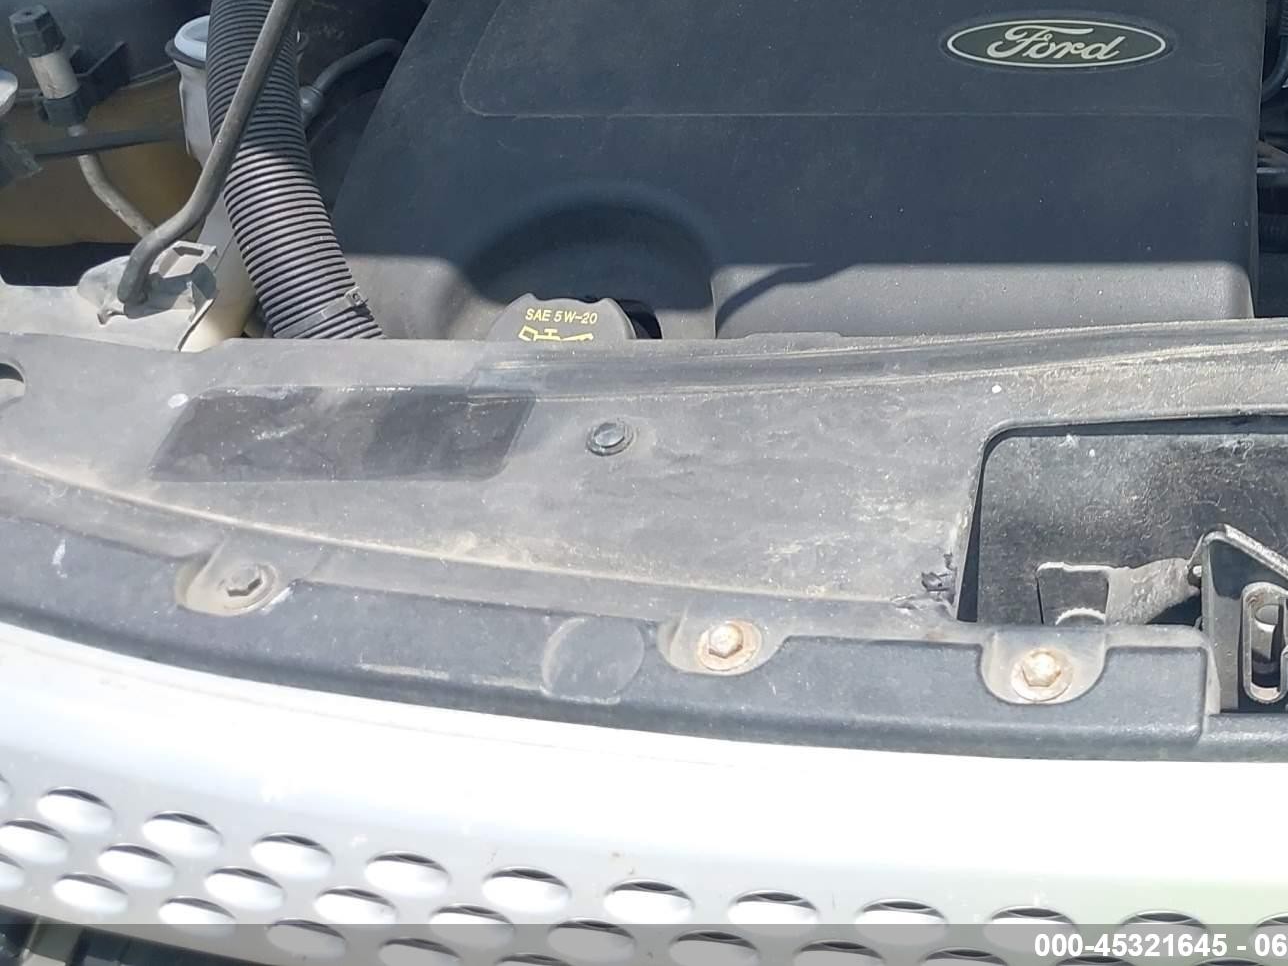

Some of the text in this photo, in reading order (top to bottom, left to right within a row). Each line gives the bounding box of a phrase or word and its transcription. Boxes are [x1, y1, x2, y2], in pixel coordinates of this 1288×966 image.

[986, 24, 1126, 60] Ford
[525, 307, 598, 325] SAE 5W-20
